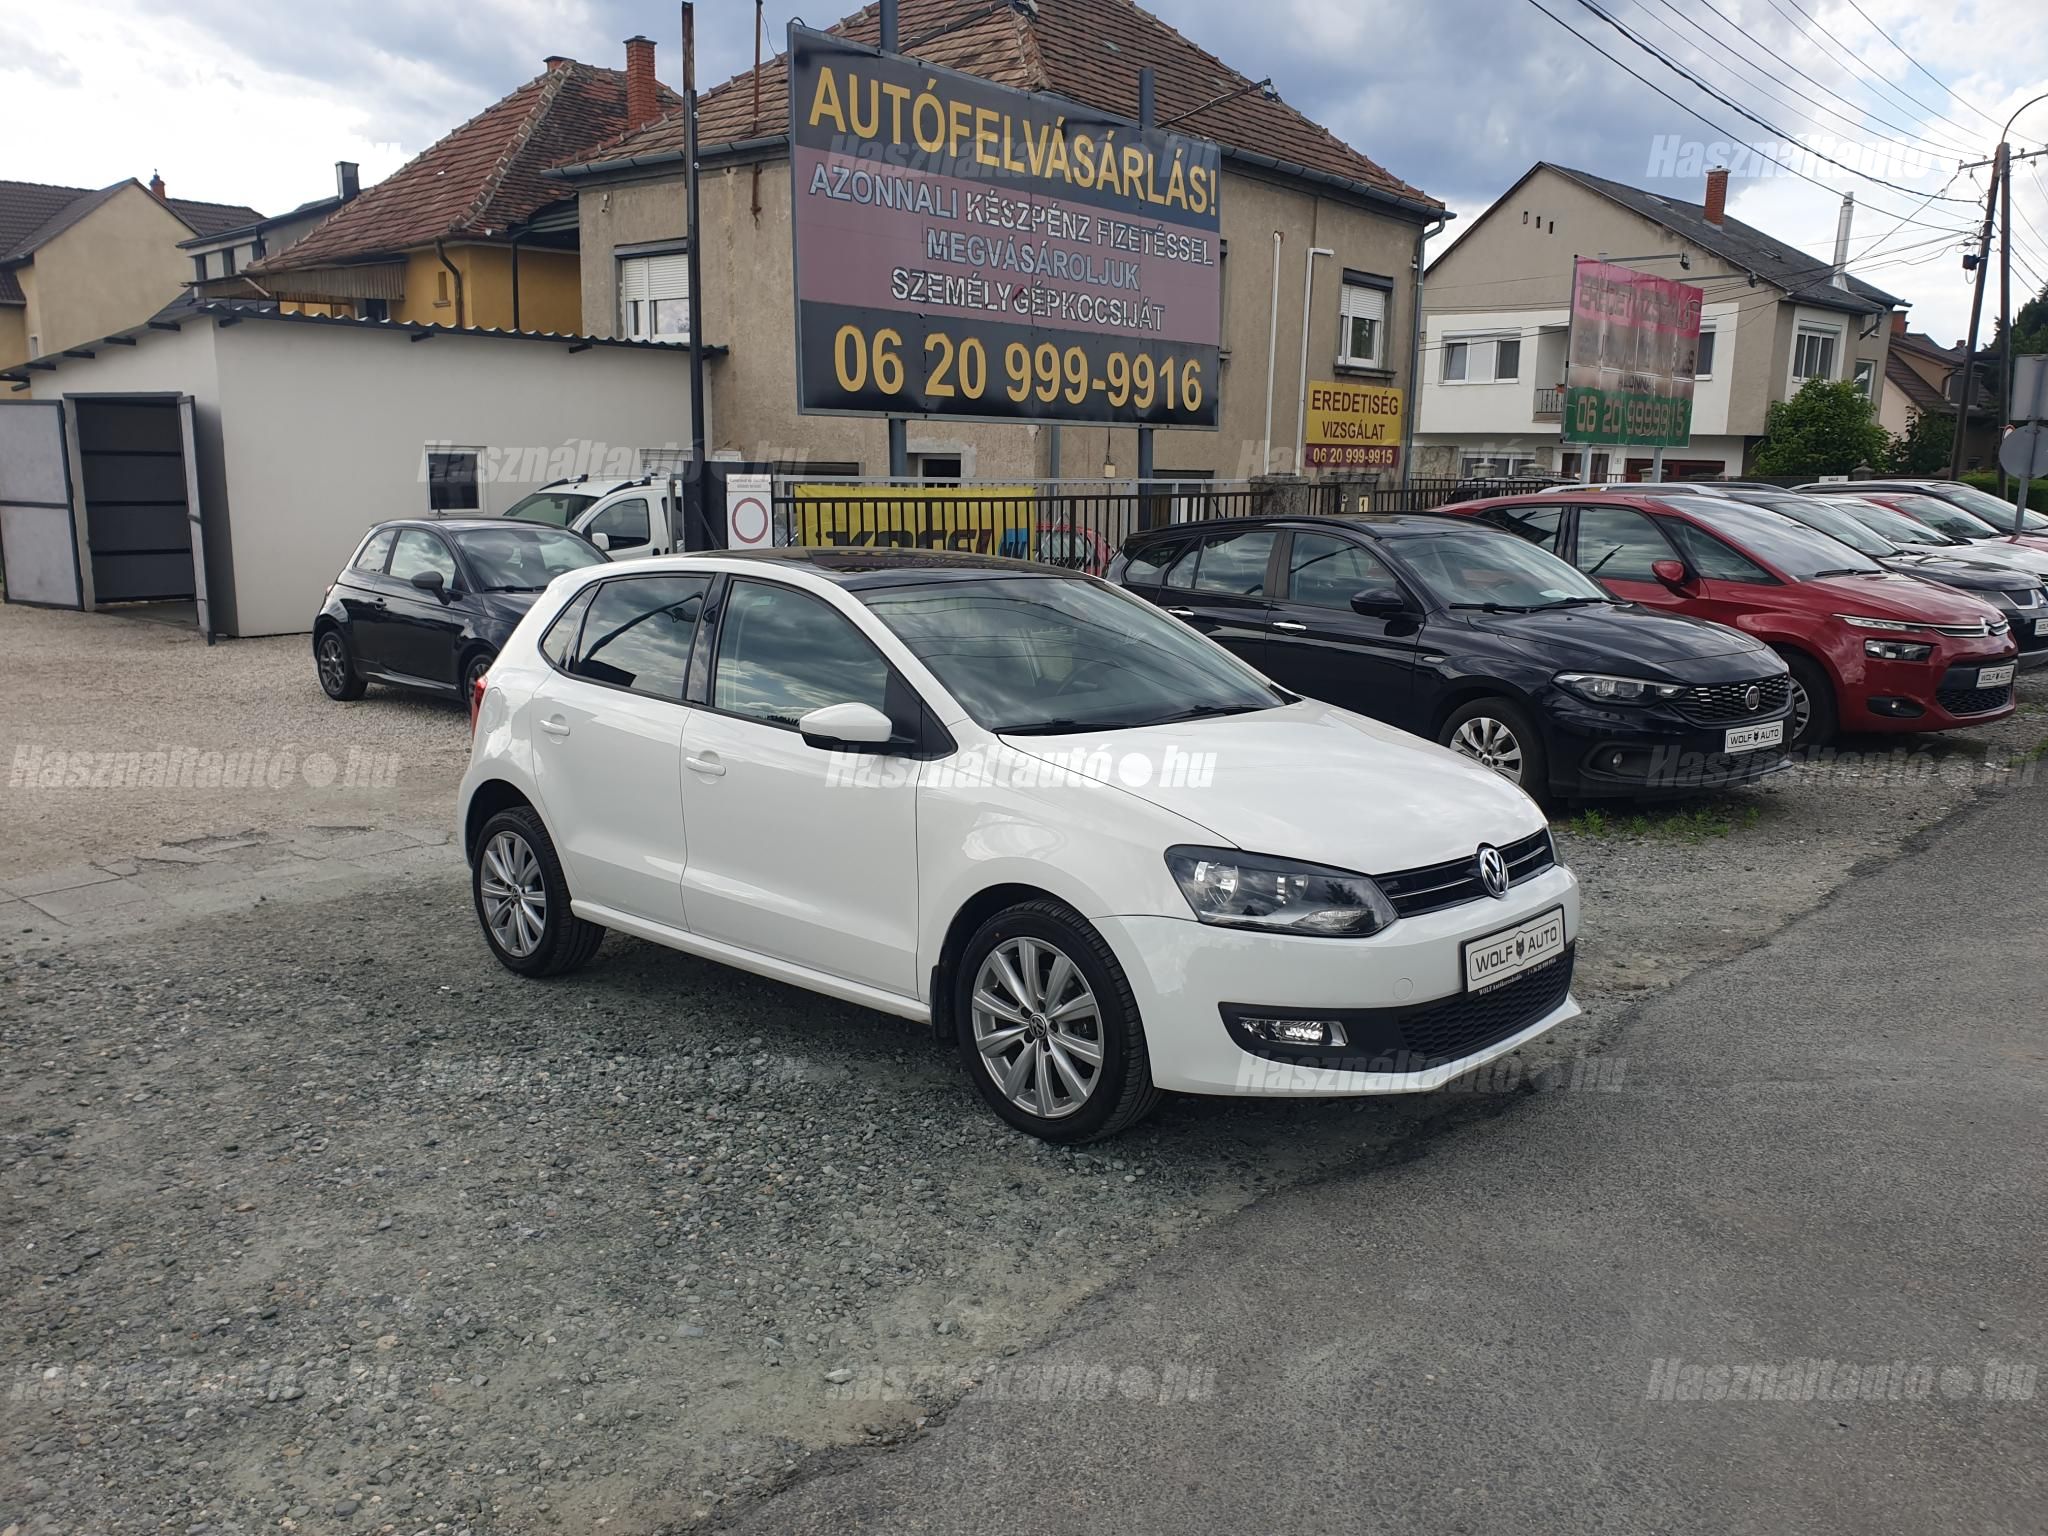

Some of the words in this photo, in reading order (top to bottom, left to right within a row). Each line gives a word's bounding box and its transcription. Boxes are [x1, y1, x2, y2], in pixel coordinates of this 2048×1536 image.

[808, 65, 1217, 216] AUTÓFELVÁSÁRLÁS!
[808, 163, 959, 220] AZONNALI
[965, 191, 1091, 243] KÉSZPÉNZ
[1096, 217, 1214, 266] FIZETÉSSEL
[926, 228, 1140, 290] MEGVÁSÁROLJUK
[891, 268, 1165, 331] SZEMÉLYGÉPKOCSIJÁT
[834, 324, 905, 396] 06
[924, 332, 987, 400] 20
[1005, 342, 1202, 412] 999-9916
[1311, 389, 1399, 416] EREDETISÉG
[1576, 394, 1598, 433] 06
[1602, 397, 1622, 434] 20
[1322, 419, 1386, 440] VIZSGÁLAT
[1313, 447, 1327, 463] 06
[1330, 447, 1343, 463] 20
[1346, 448, 1393, 464] 999-9915
[1730, 733, 1752, 745] WOLF
[1760, 728, 1779, 740] AUTO
[1475, 944, 1513, 973] WOLF
[1527, 926, 1557, 954] AUTO
